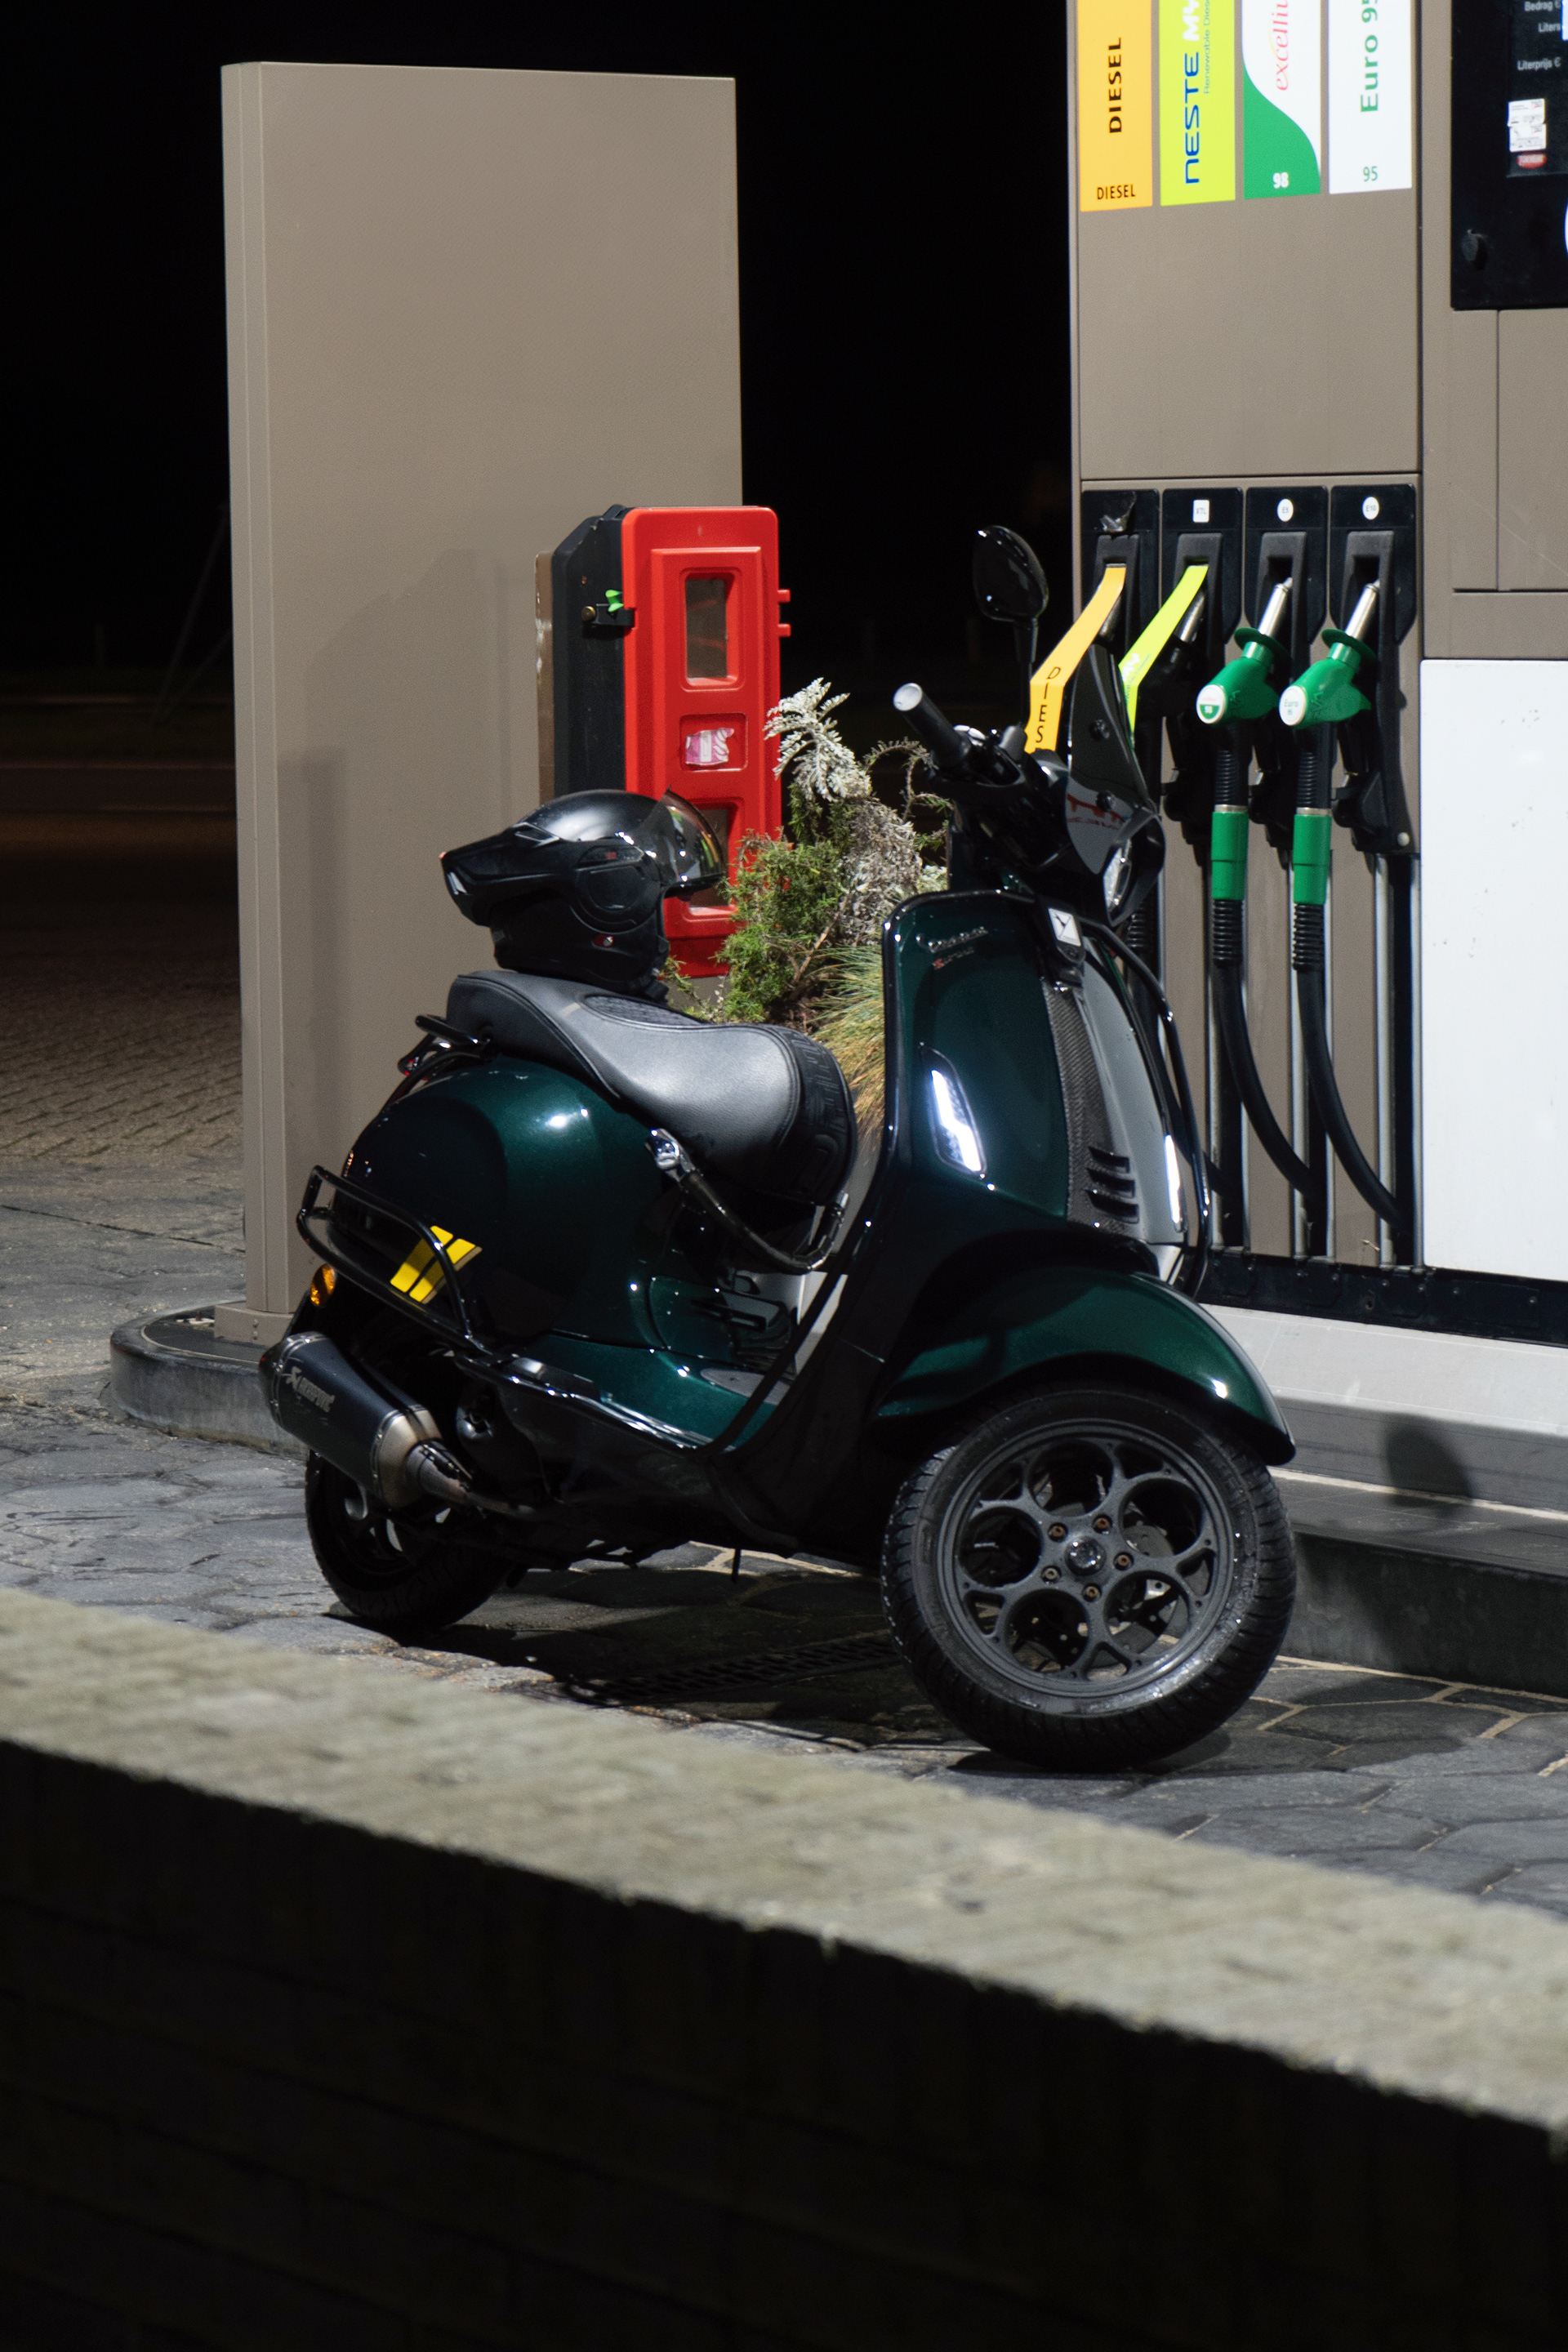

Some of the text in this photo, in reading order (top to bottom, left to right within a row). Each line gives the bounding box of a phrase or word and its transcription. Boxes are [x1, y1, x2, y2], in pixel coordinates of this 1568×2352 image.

[1360, 34, 1379, 113] Euro
[1107, 37, 1122, 134] DIESEL
[1184, 51, 1200, 184] NESTE
[1272, 172, 1290, 189] 98
[1363, 166, 1378, 182] 95
[1097, 184, 1136, 200] DIESEL
[1284, 698, 1299, 708] Euro
